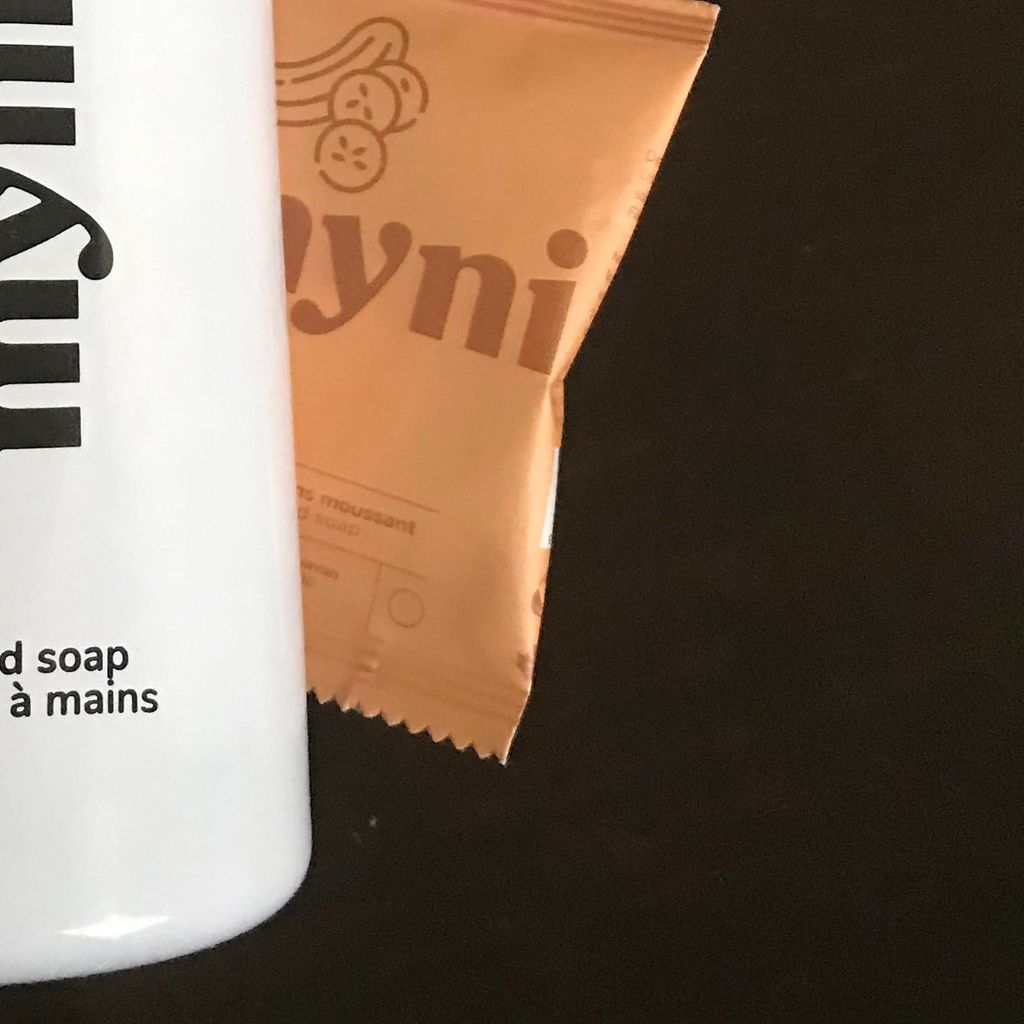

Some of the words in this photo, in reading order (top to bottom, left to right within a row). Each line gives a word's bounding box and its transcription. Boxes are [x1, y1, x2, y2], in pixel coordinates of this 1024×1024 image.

[320, 494, 416, 536] moussant
[37, 646, 129, 680] soap
[10, 681, 31, 718] à
[46, 678, 158, 717] mains
